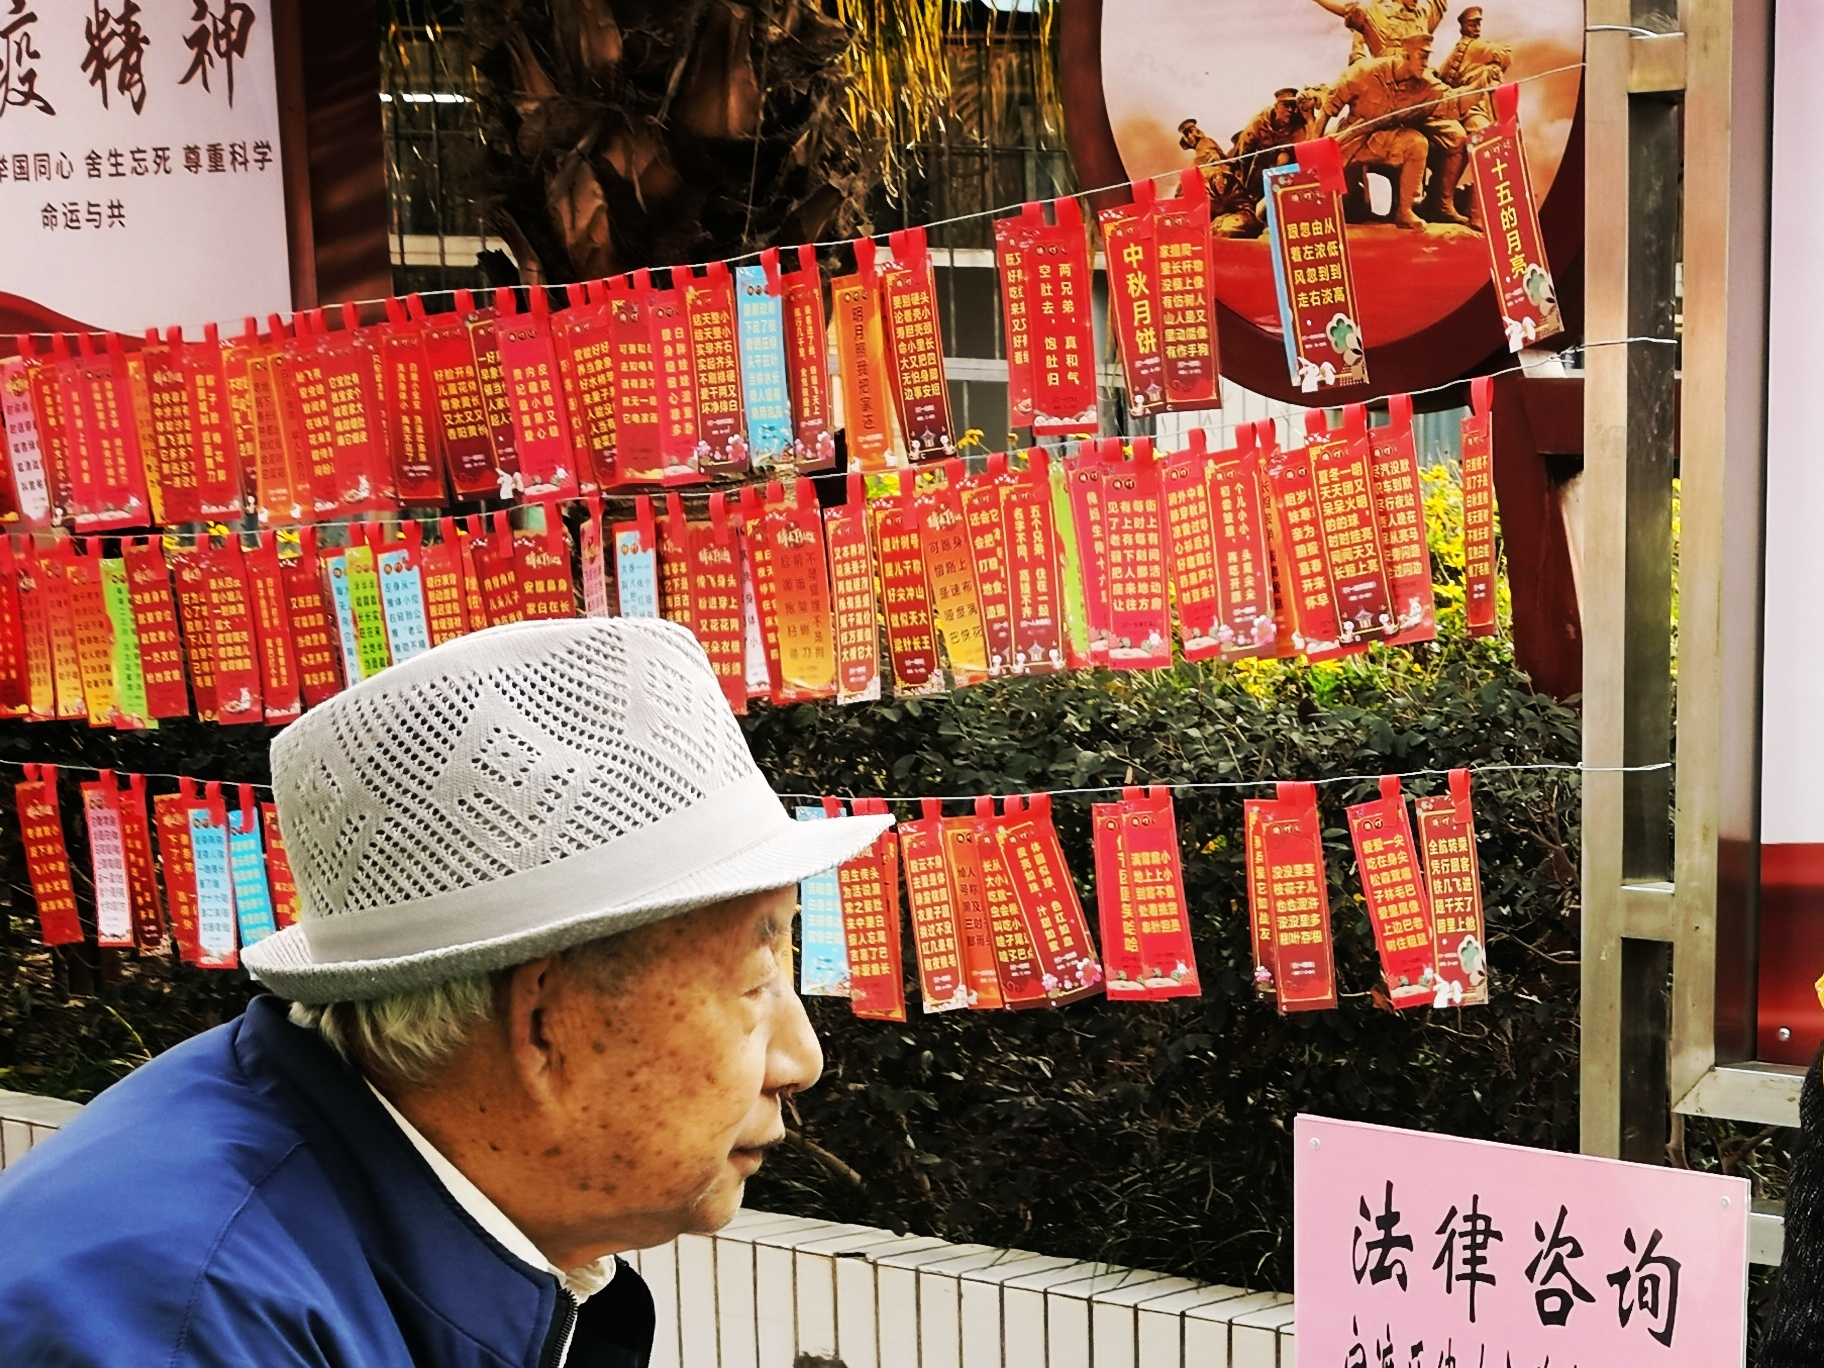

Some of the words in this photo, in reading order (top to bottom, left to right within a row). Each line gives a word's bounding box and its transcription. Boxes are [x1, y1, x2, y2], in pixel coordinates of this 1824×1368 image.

[85, 147, 172, 178] 舍生忘死
[183, 140, 273, 175] 尊重科学
[41, 199, 127, 231] 命运与共
[1287, 222, 1310, 308] 跟着风走
[1300, 219, 1322, 306] 忽左忽右
[1311, 217, 1334, 304] 由浓到淡
[1324, 216, 1345, 303] 从低到高
[1490, 158, 1528, 280] 十五的月亮
[901, 294, 923, 399] 别看胆小又怕事
[1122, 243, 1158, 355] 中秋月饼
[1107, 501, 1125, 612] 见了老弱把座让
[1120, 500, 1138, 612] 有上有下人来往
[1145, 499, 1163, 610] 街上有间活动房
[1318, 469, 1346, 580] 夏天呆的时间长
[1329, 466, 1357, 578] 冬天呆的时间短
[901, 534, 922, 651] 树干冲天长
[910, 533, 931, 650] 号称山大王
[1352, 1180, 1682, 1347] 法律咨询
